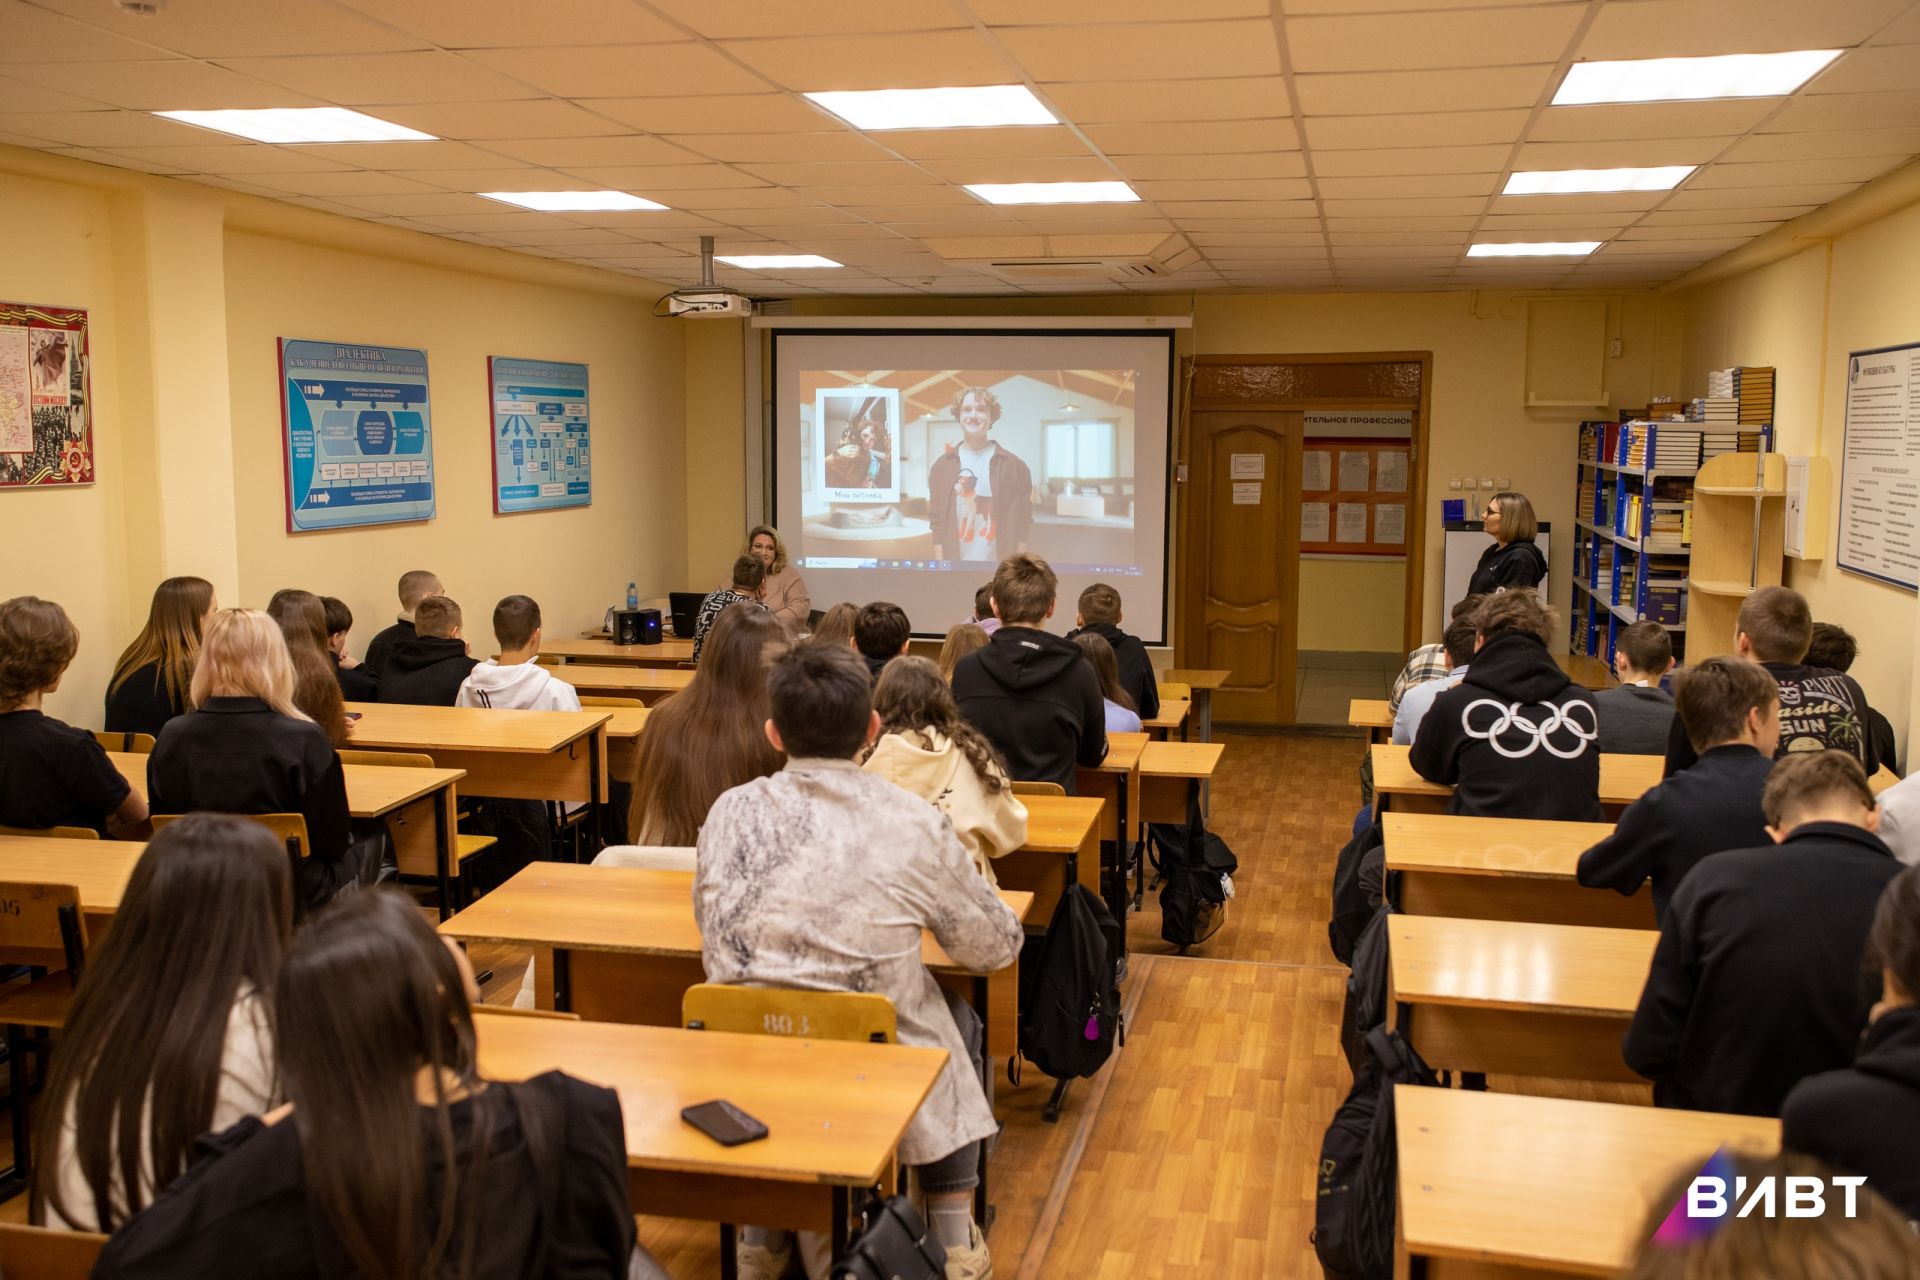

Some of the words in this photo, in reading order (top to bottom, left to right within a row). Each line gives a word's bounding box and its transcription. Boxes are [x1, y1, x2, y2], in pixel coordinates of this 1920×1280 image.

[335, 347, 386, 361] ДИАЛЕКТИКА
[1801, 675, 1856, 710] PARTY
[1779, 718, 1827, 736] SUN
